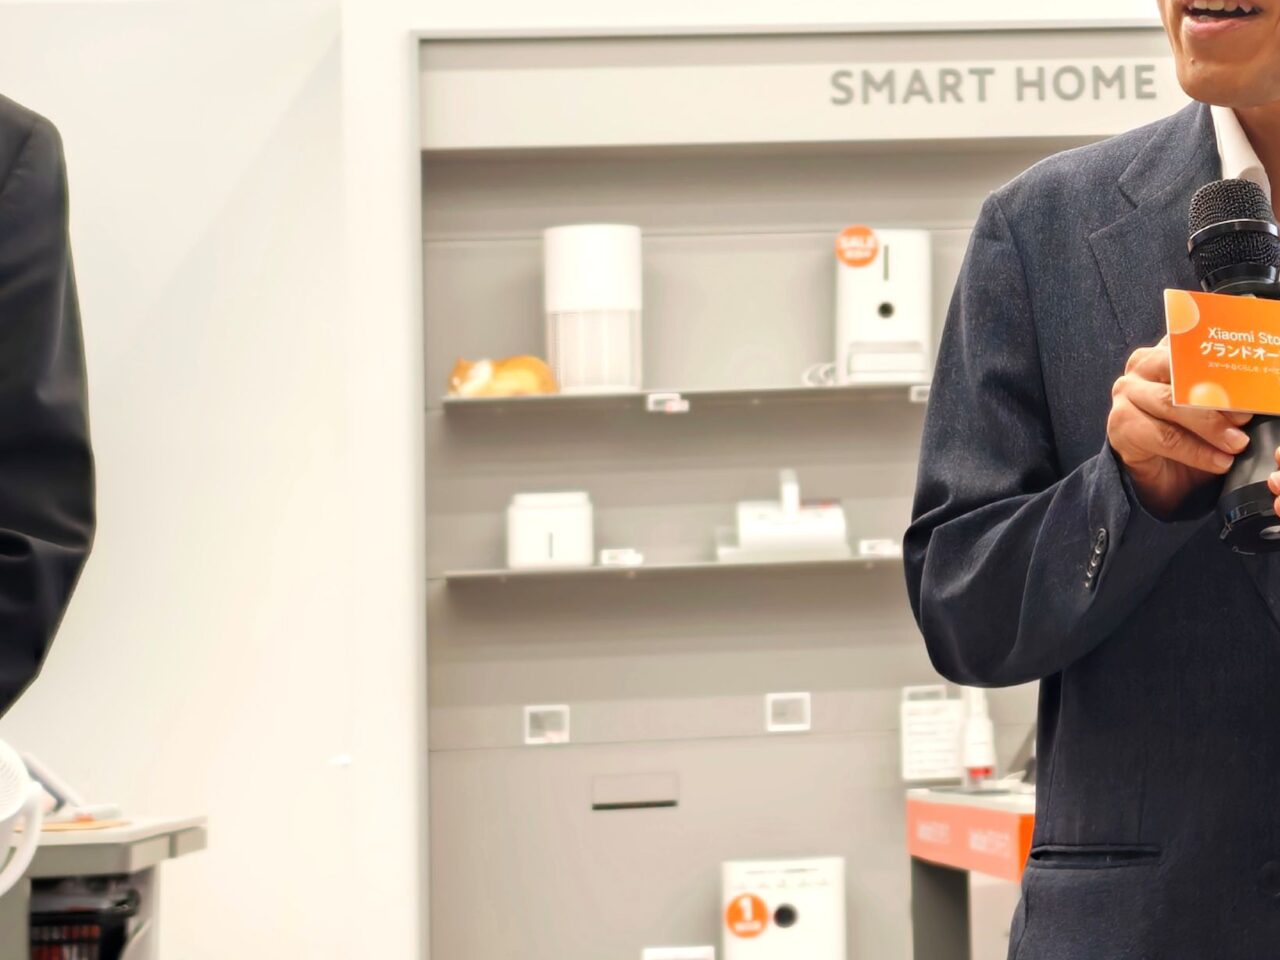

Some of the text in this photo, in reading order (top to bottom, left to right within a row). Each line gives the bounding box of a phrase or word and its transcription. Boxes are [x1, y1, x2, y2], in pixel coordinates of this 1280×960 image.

[829, 63, 1158, 106] SMART HOME
[1208, 327, 1255, 343] Xiaomi
